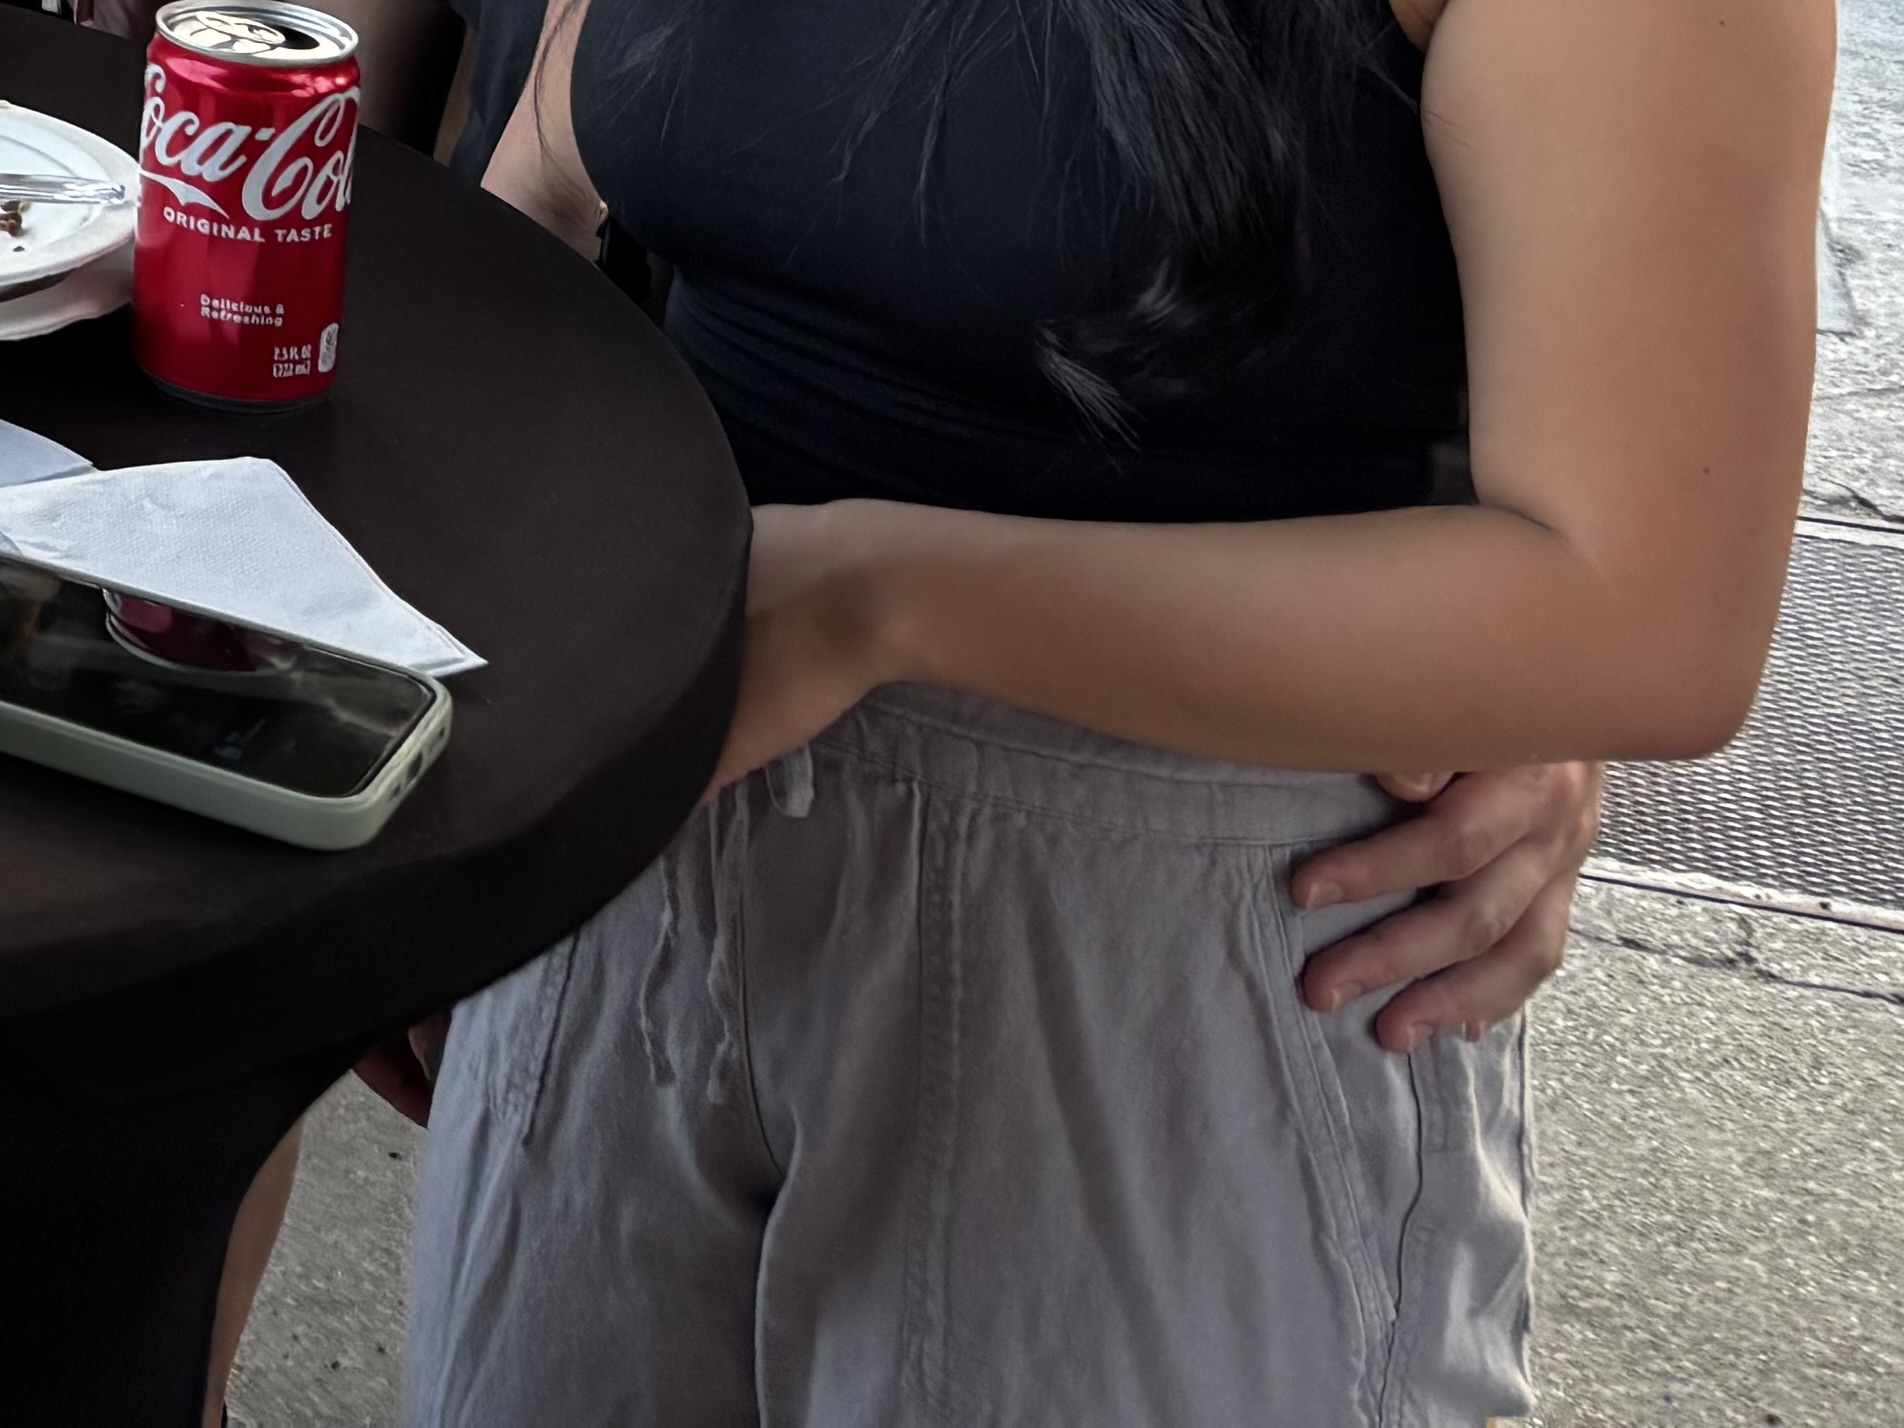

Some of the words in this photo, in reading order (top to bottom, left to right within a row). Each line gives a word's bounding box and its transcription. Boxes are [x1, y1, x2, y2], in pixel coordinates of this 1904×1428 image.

[164, 206, 266, 243] ORIGINAL
[274, 223, 332, 243] TASTE
[200, 306, 283, 327] Refreshing
